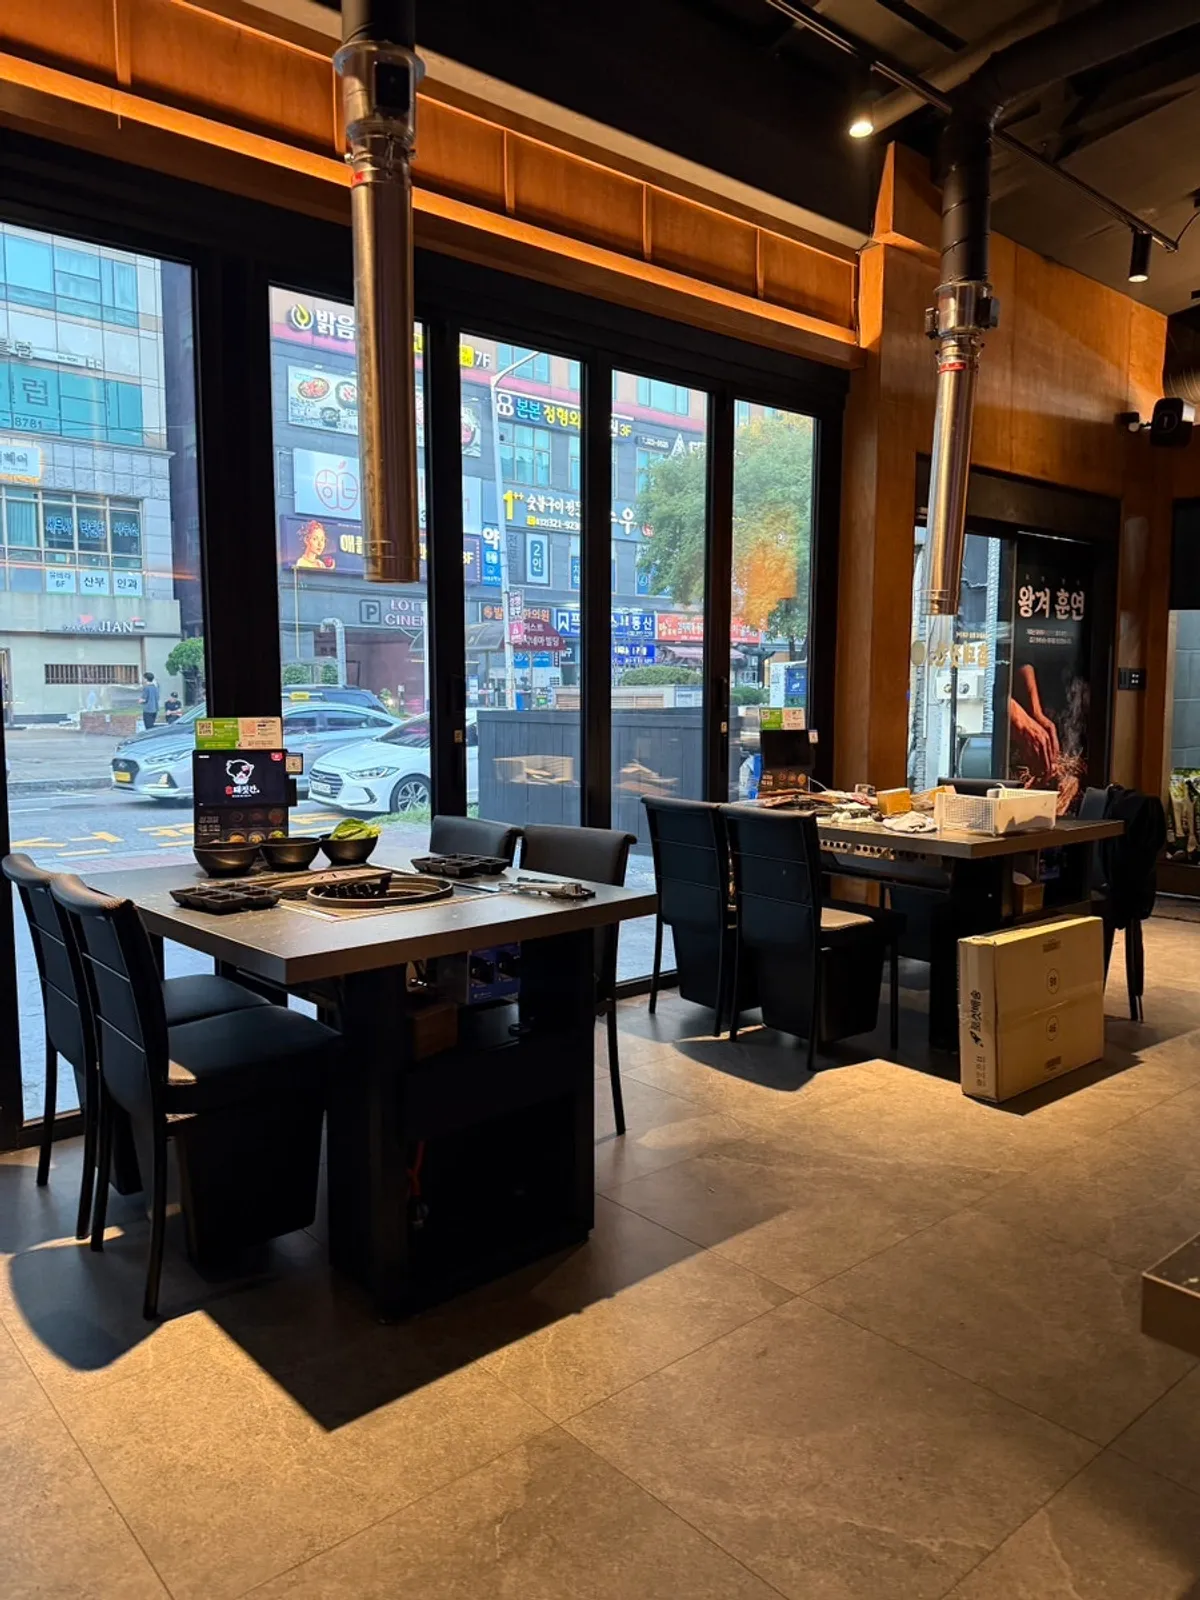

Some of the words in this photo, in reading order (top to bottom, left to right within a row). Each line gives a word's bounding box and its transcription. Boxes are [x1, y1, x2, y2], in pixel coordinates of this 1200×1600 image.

[475, 350, 491, 367] 7F
[84, 577, 105, 588] 산부
[1054, 588, 1085, 621] 훈연
[99, 621, 133, 633] JIAN
